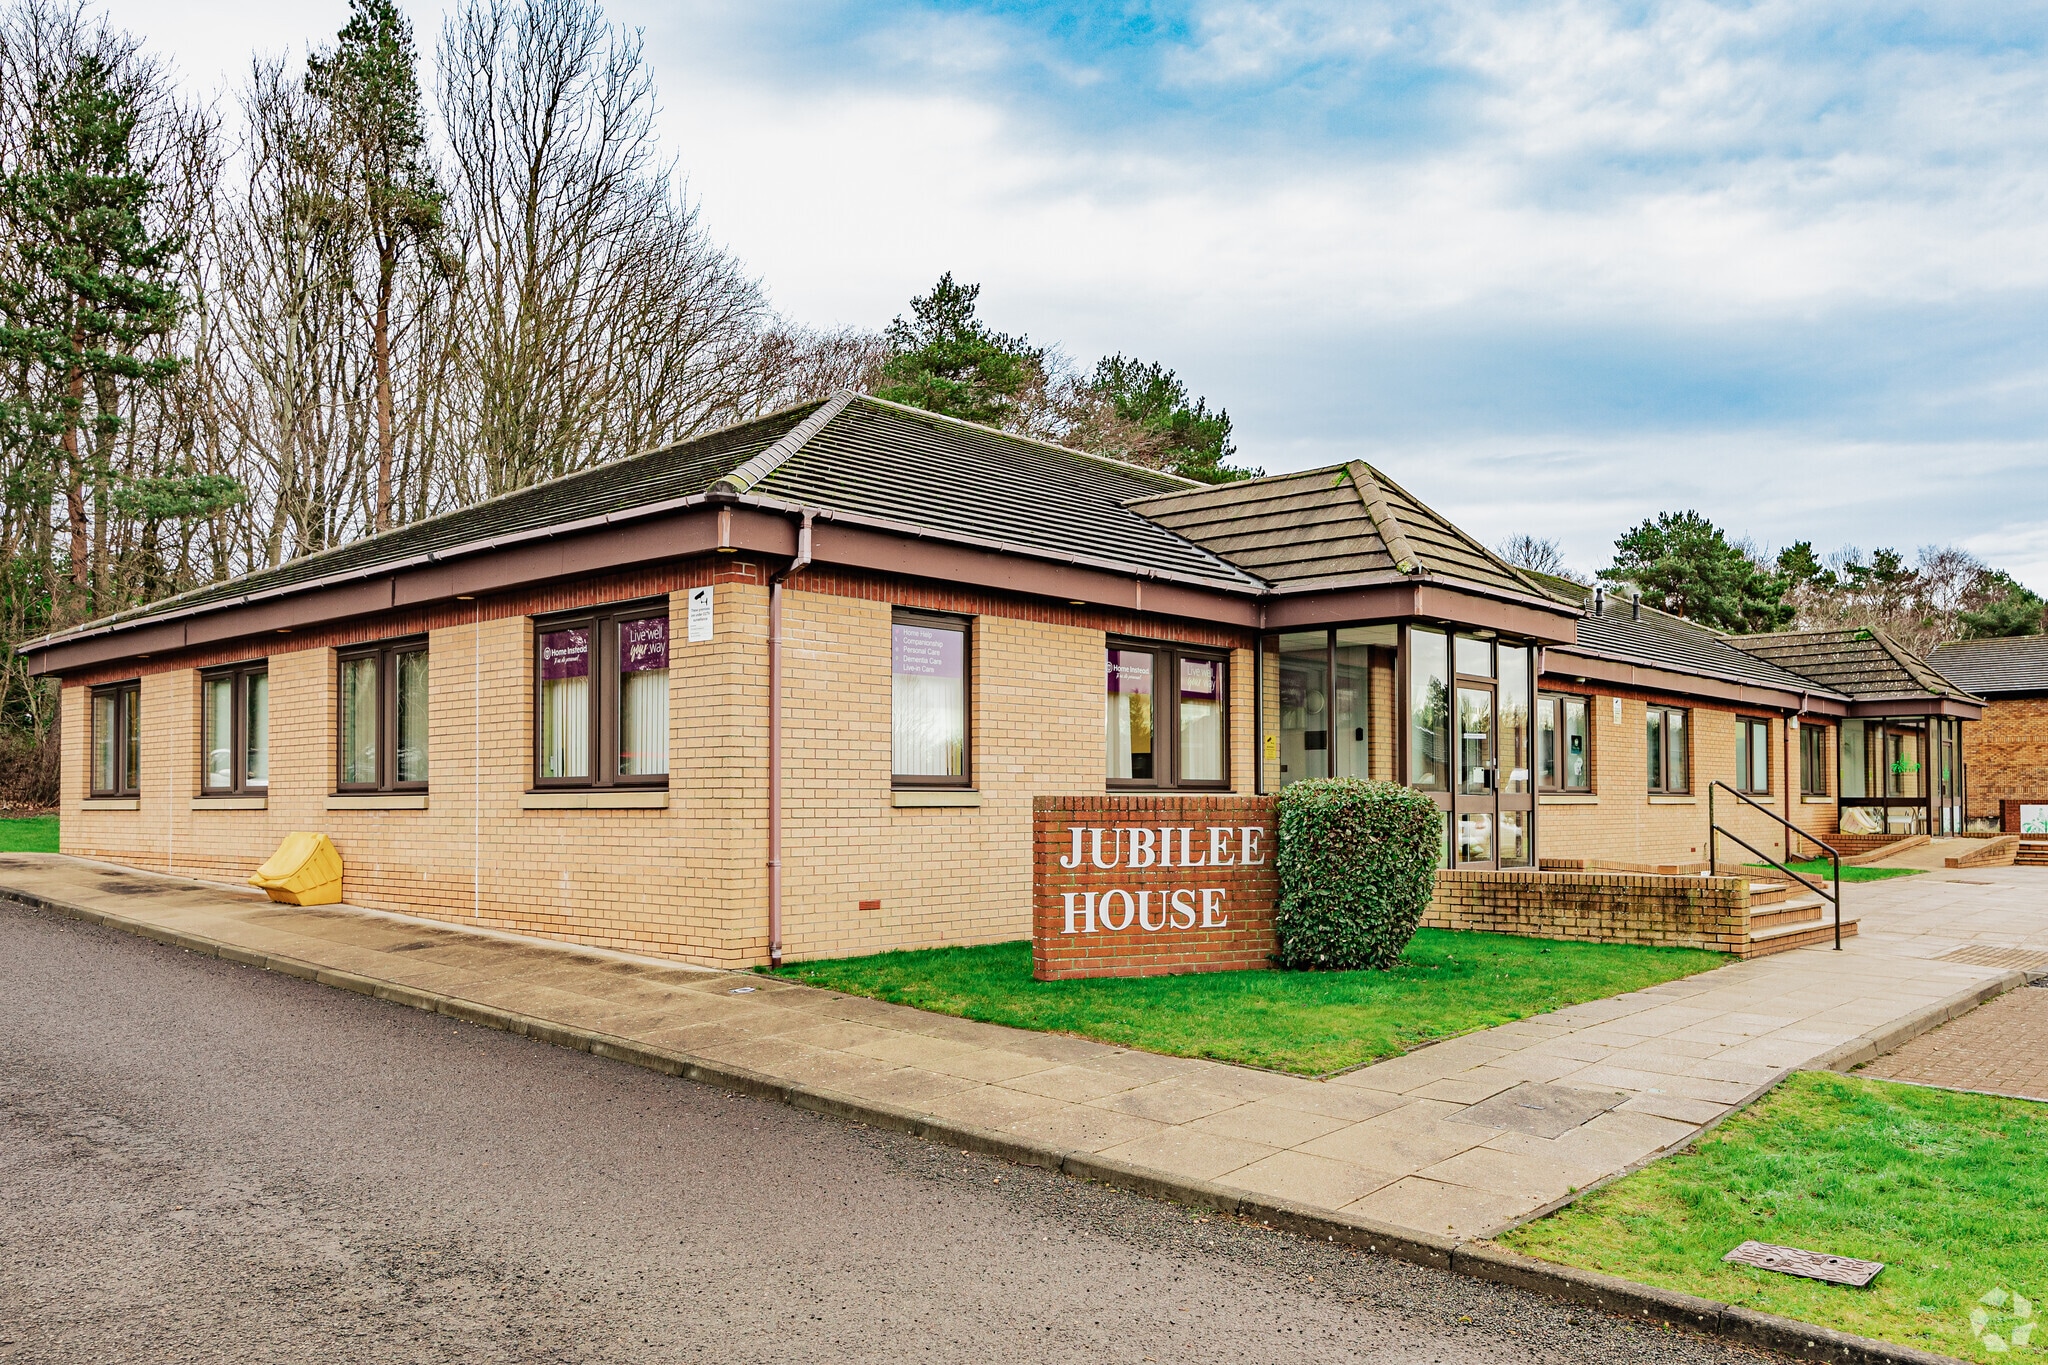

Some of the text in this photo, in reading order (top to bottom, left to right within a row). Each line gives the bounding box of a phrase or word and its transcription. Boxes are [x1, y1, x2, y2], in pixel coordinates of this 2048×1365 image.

[630, 630, 646, 642] Live
[903, 629, 932, 639] Home Help
[903, 636, 943, 648] Companionship
[567, 645, 588, 654] Instead
[650, 642, 666, 656] way
[903, 646, 940, 656] Personal Care
[903, 655, 942, 665] Dementia Care
[921, 665, 935, 673] Care
[1113, 664, 1149, 674] Home Instead
[1059, 826, 1265, 869] JUBILEE
[1060, 888, 1228, 934] HOUSE
